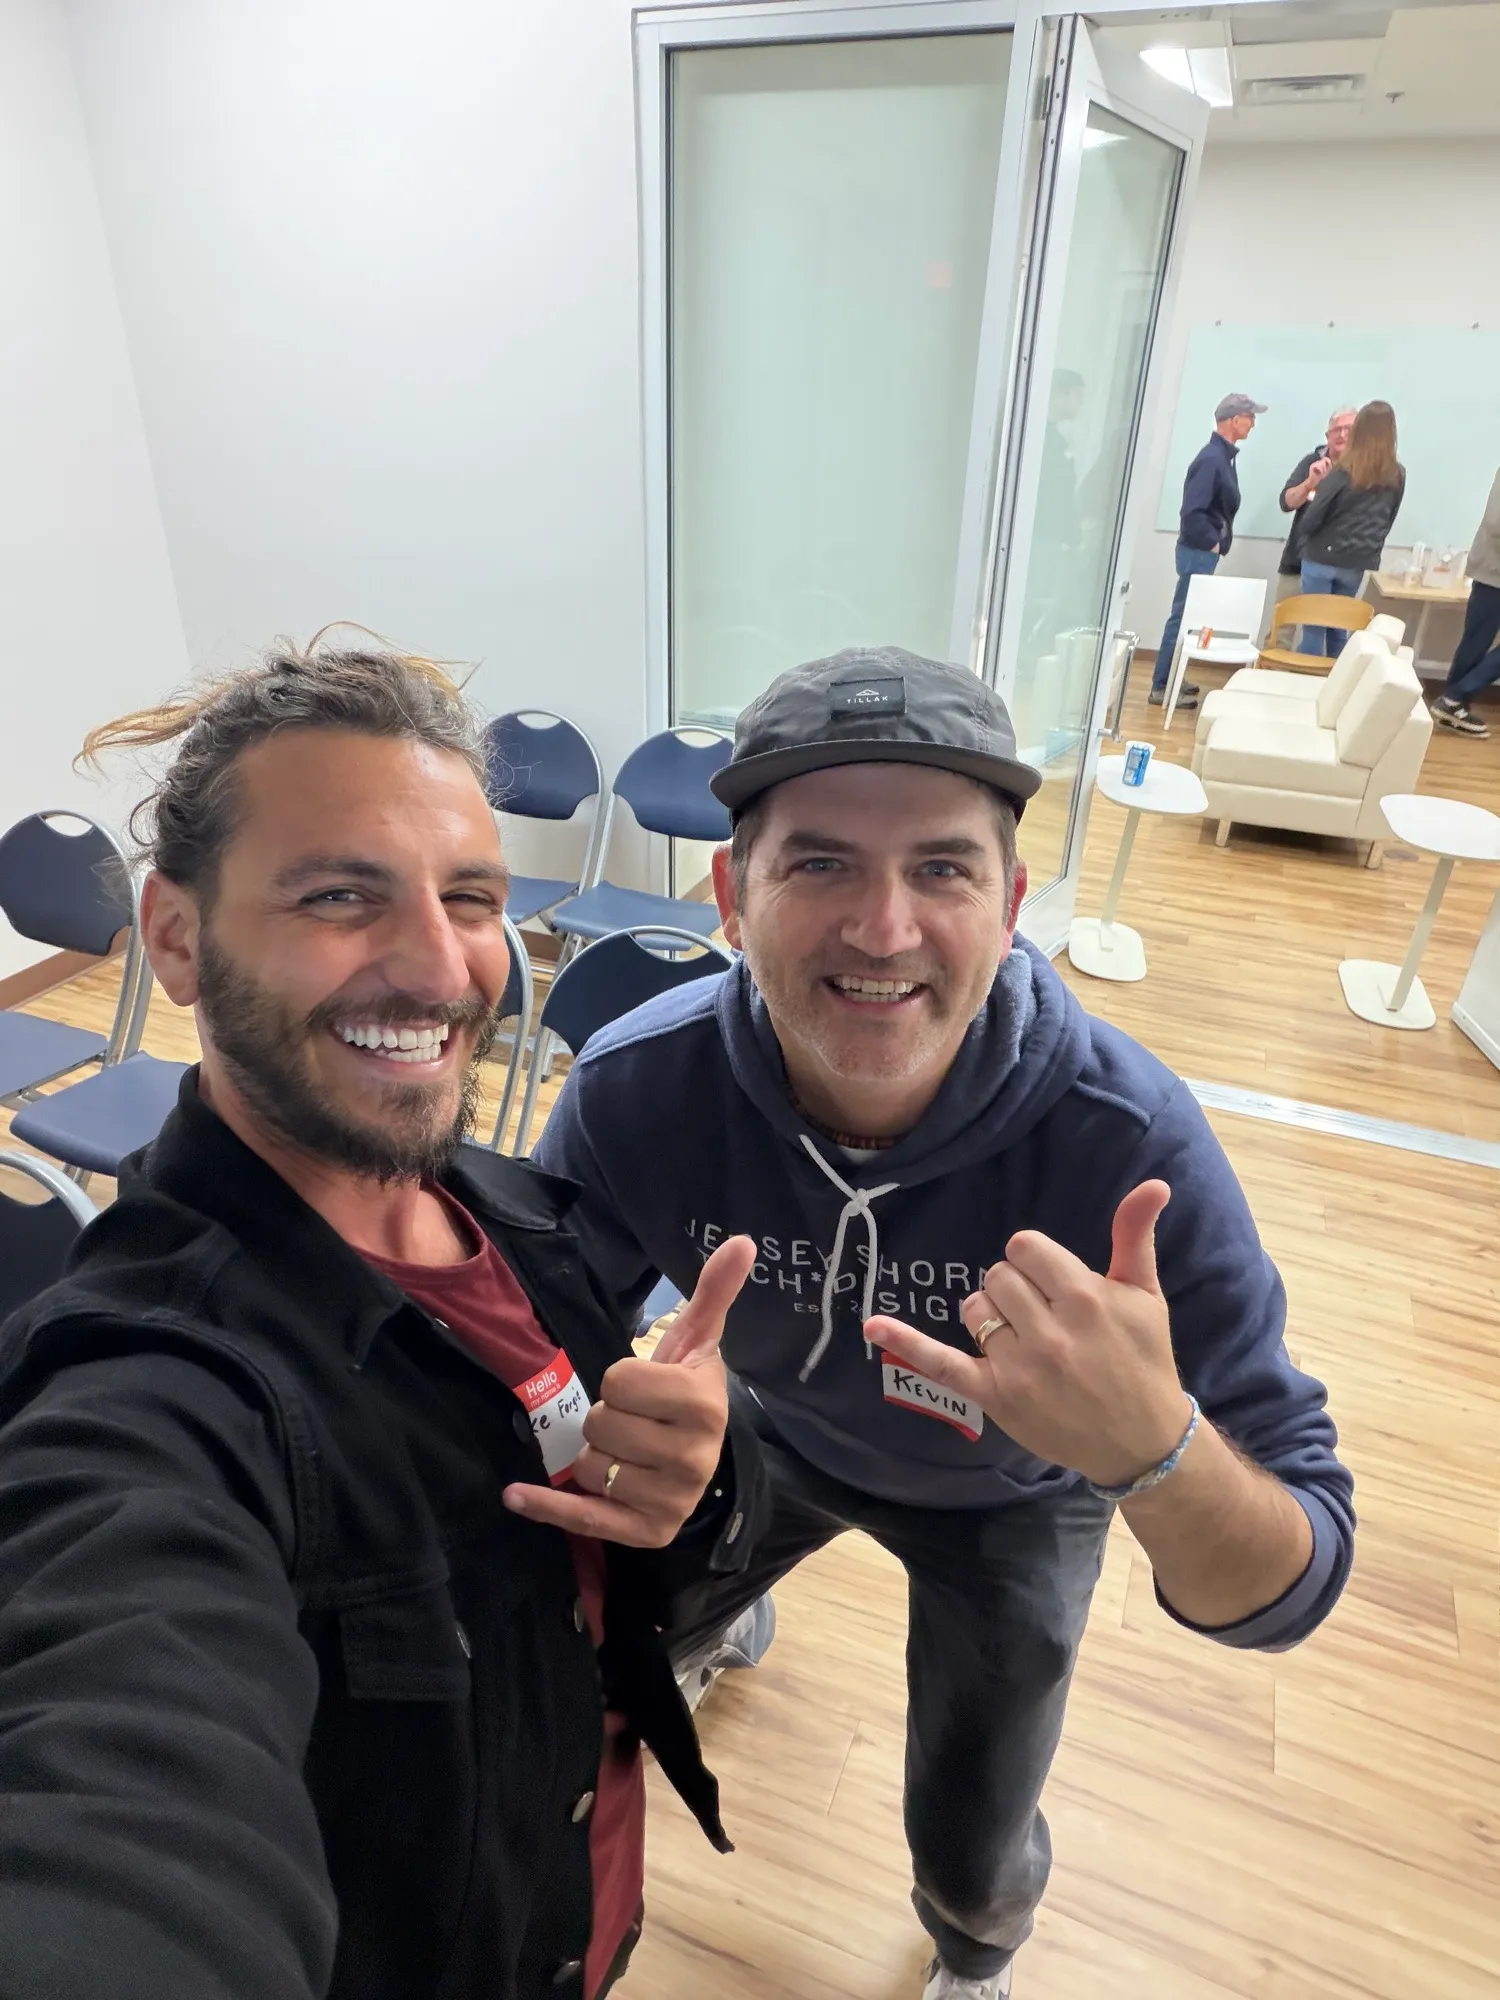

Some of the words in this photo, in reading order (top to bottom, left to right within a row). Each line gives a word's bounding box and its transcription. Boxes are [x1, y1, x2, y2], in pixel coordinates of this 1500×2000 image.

[846, 695, 888, 704] TILLAK
[684, 1218, 837, 1271] JESEY
[525, 1371, 557, 1399] Hello
[893, 1369, 967, 1416] KEVIN
